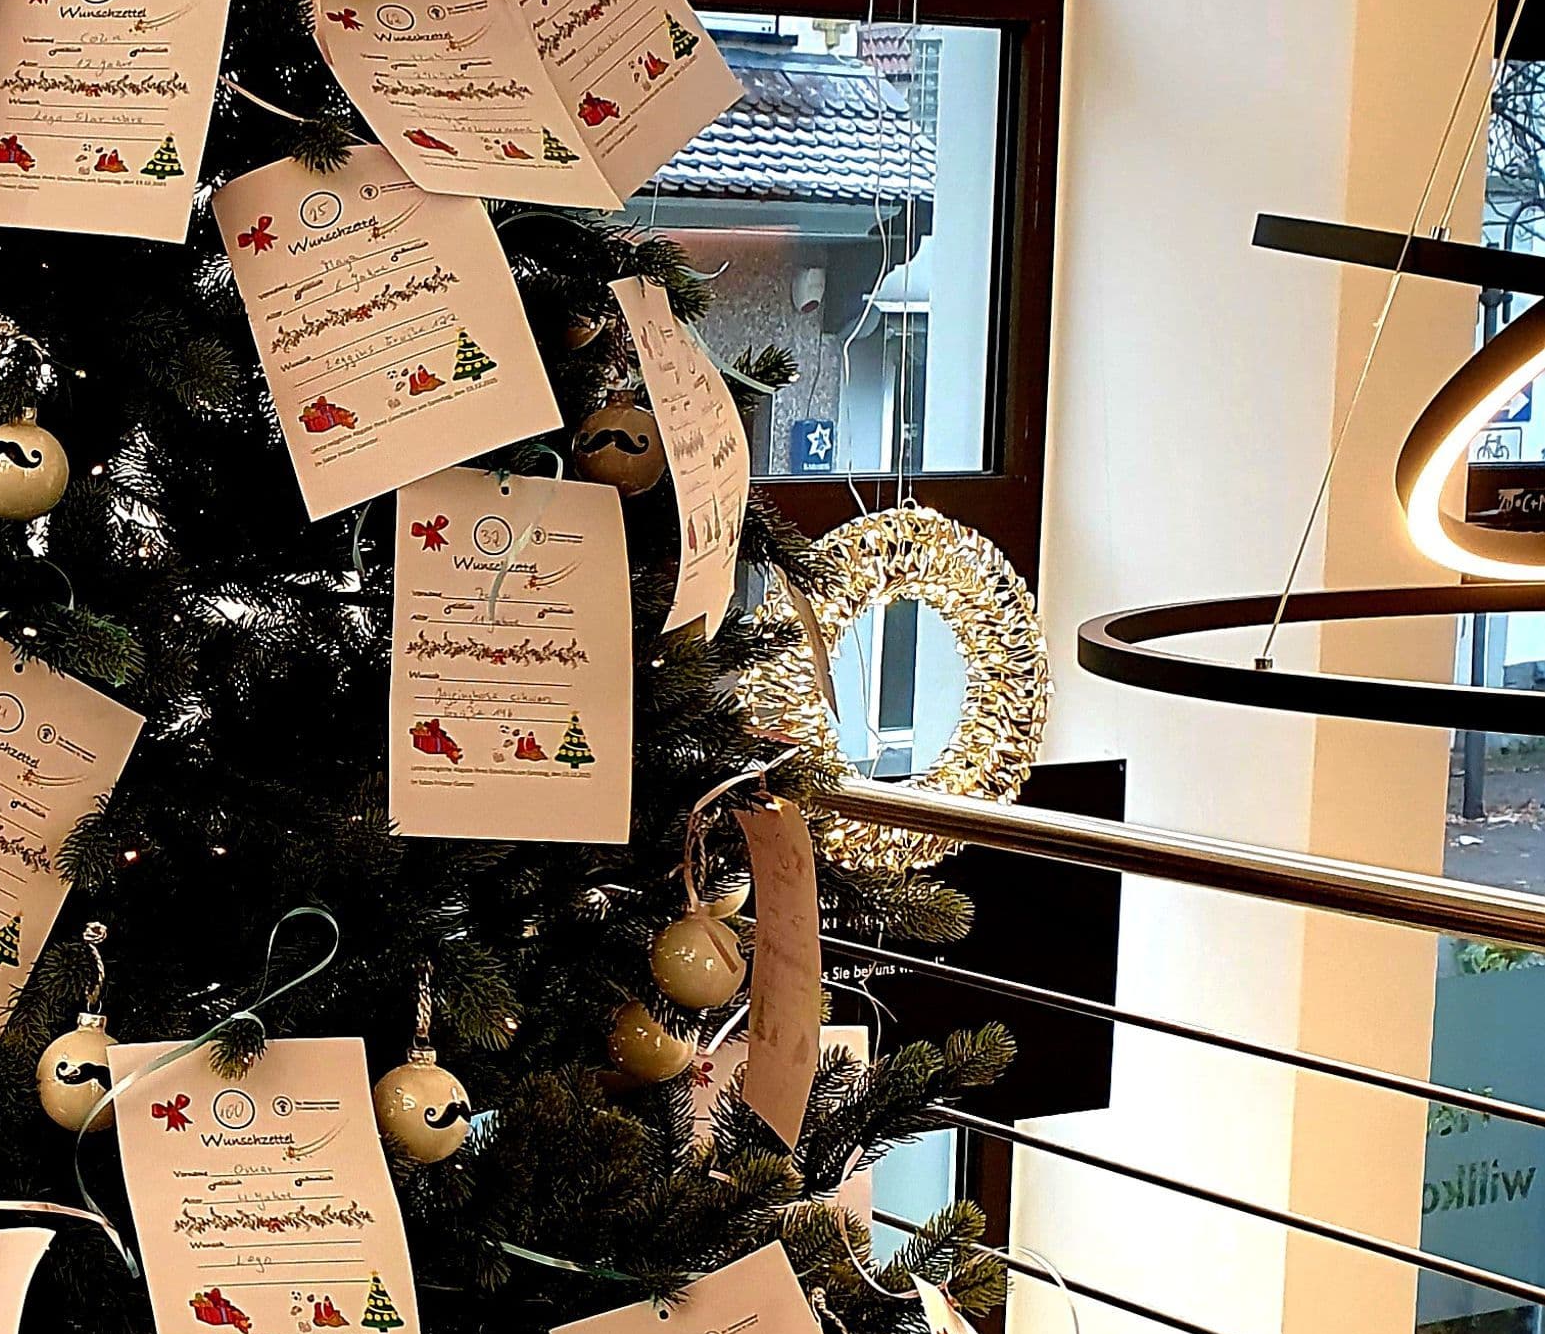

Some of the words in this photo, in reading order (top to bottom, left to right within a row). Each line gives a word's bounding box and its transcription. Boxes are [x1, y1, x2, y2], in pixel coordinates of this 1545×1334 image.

[59, 5, 147, 19] Wunschzettel
[288, 215, 379, 256] Wunschzettel
[453, 555, 539, 574] Wunsczettel
[831, 966, 850, 980] Sie
[875, 965, 896, 975] uns
[200, 1132, 296, 1147] Wunschzettel
